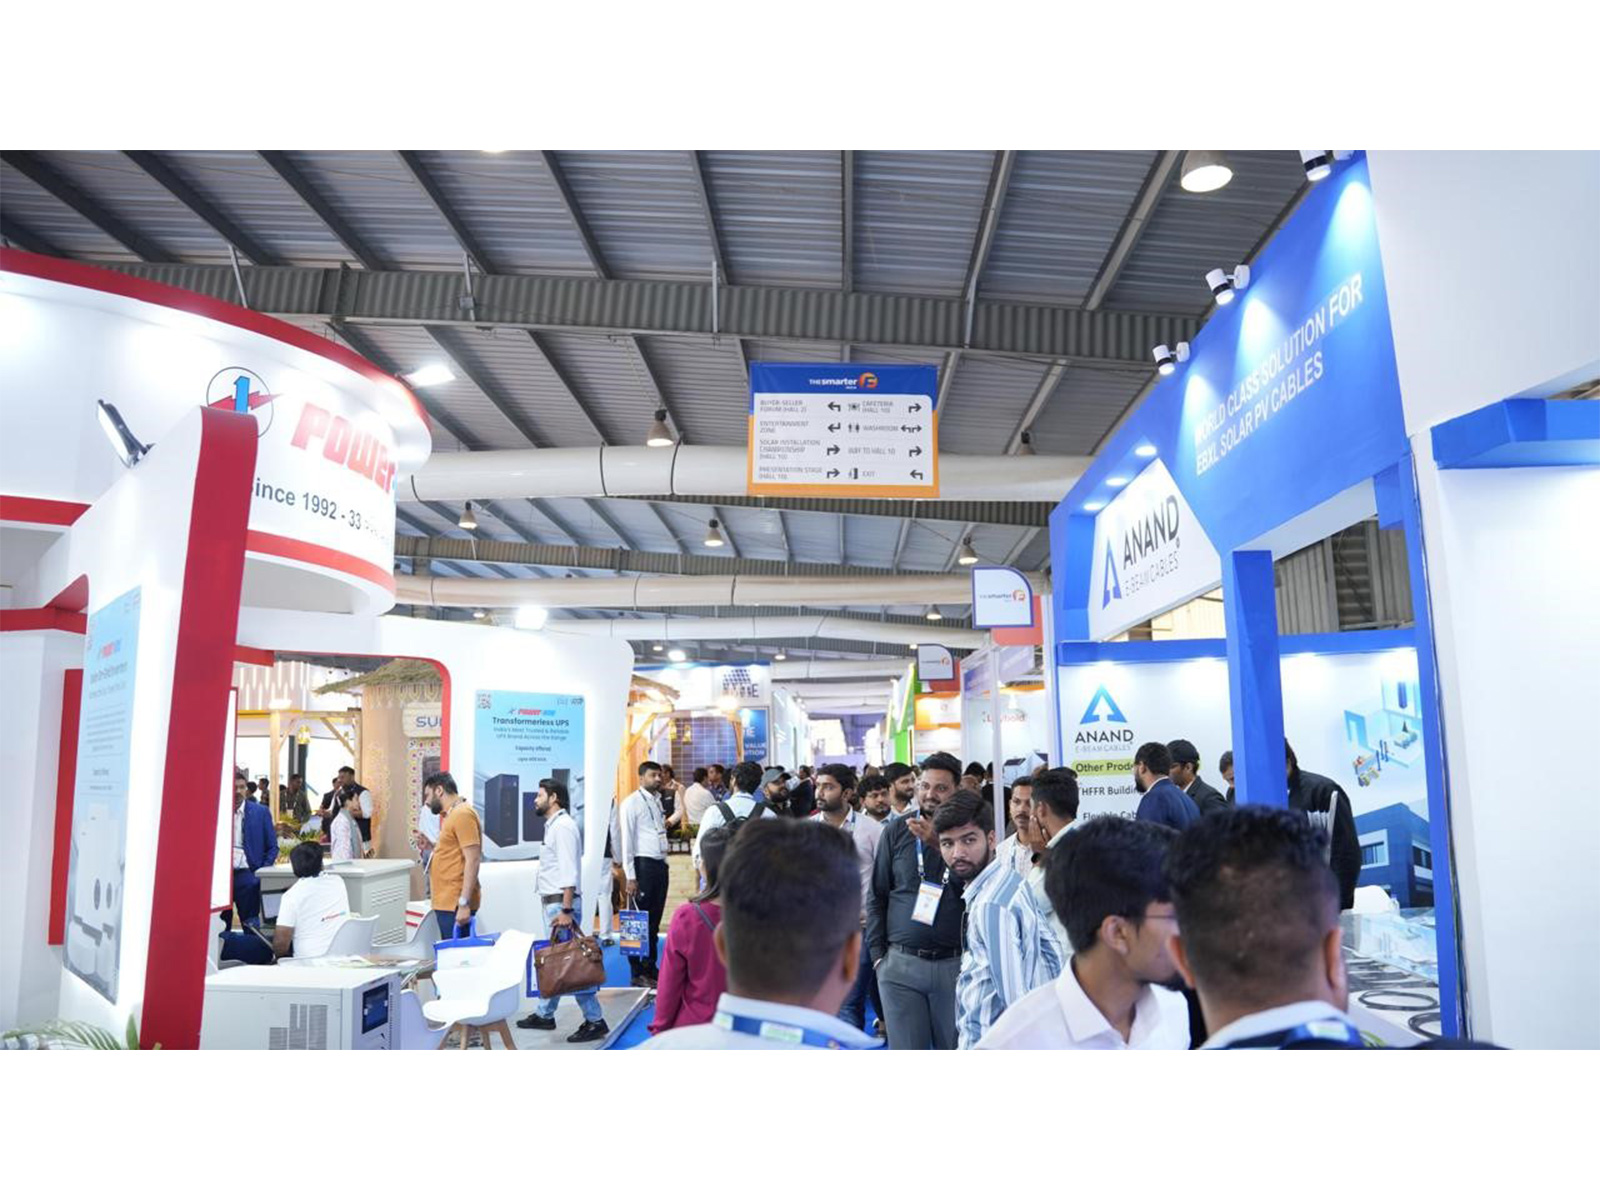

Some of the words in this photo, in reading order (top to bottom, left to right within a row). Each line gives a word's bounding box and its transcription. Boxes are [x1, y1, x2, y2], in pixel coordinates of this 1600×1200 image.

[1227, 368, 1260, 417] CLASS
[1260, 306, 1325, 386] SOLUTION
[1329, 272, 1363, 328] FOR
[821, 378, 857, 386] smarter
[1196, 442, 1219, 476] EBXL
[1220, 411, 1253, 457] SOLAR
[1254, 395, 1269, 430] PV
[1271, 351, 1323, 412] CABLES
[252, 477, 296, 506] ince
[302, 492, 338, 521] 1992
[349, 509, 362, 530] 33
[1123, 494, 1180, 571] ANAND
[493, 717, 554, 726] Transformerless
[555, 719, 570, 727] UPS
[1075, 729, 1134, 744] ANAND
[1076, 763, 1104, 773] Other
